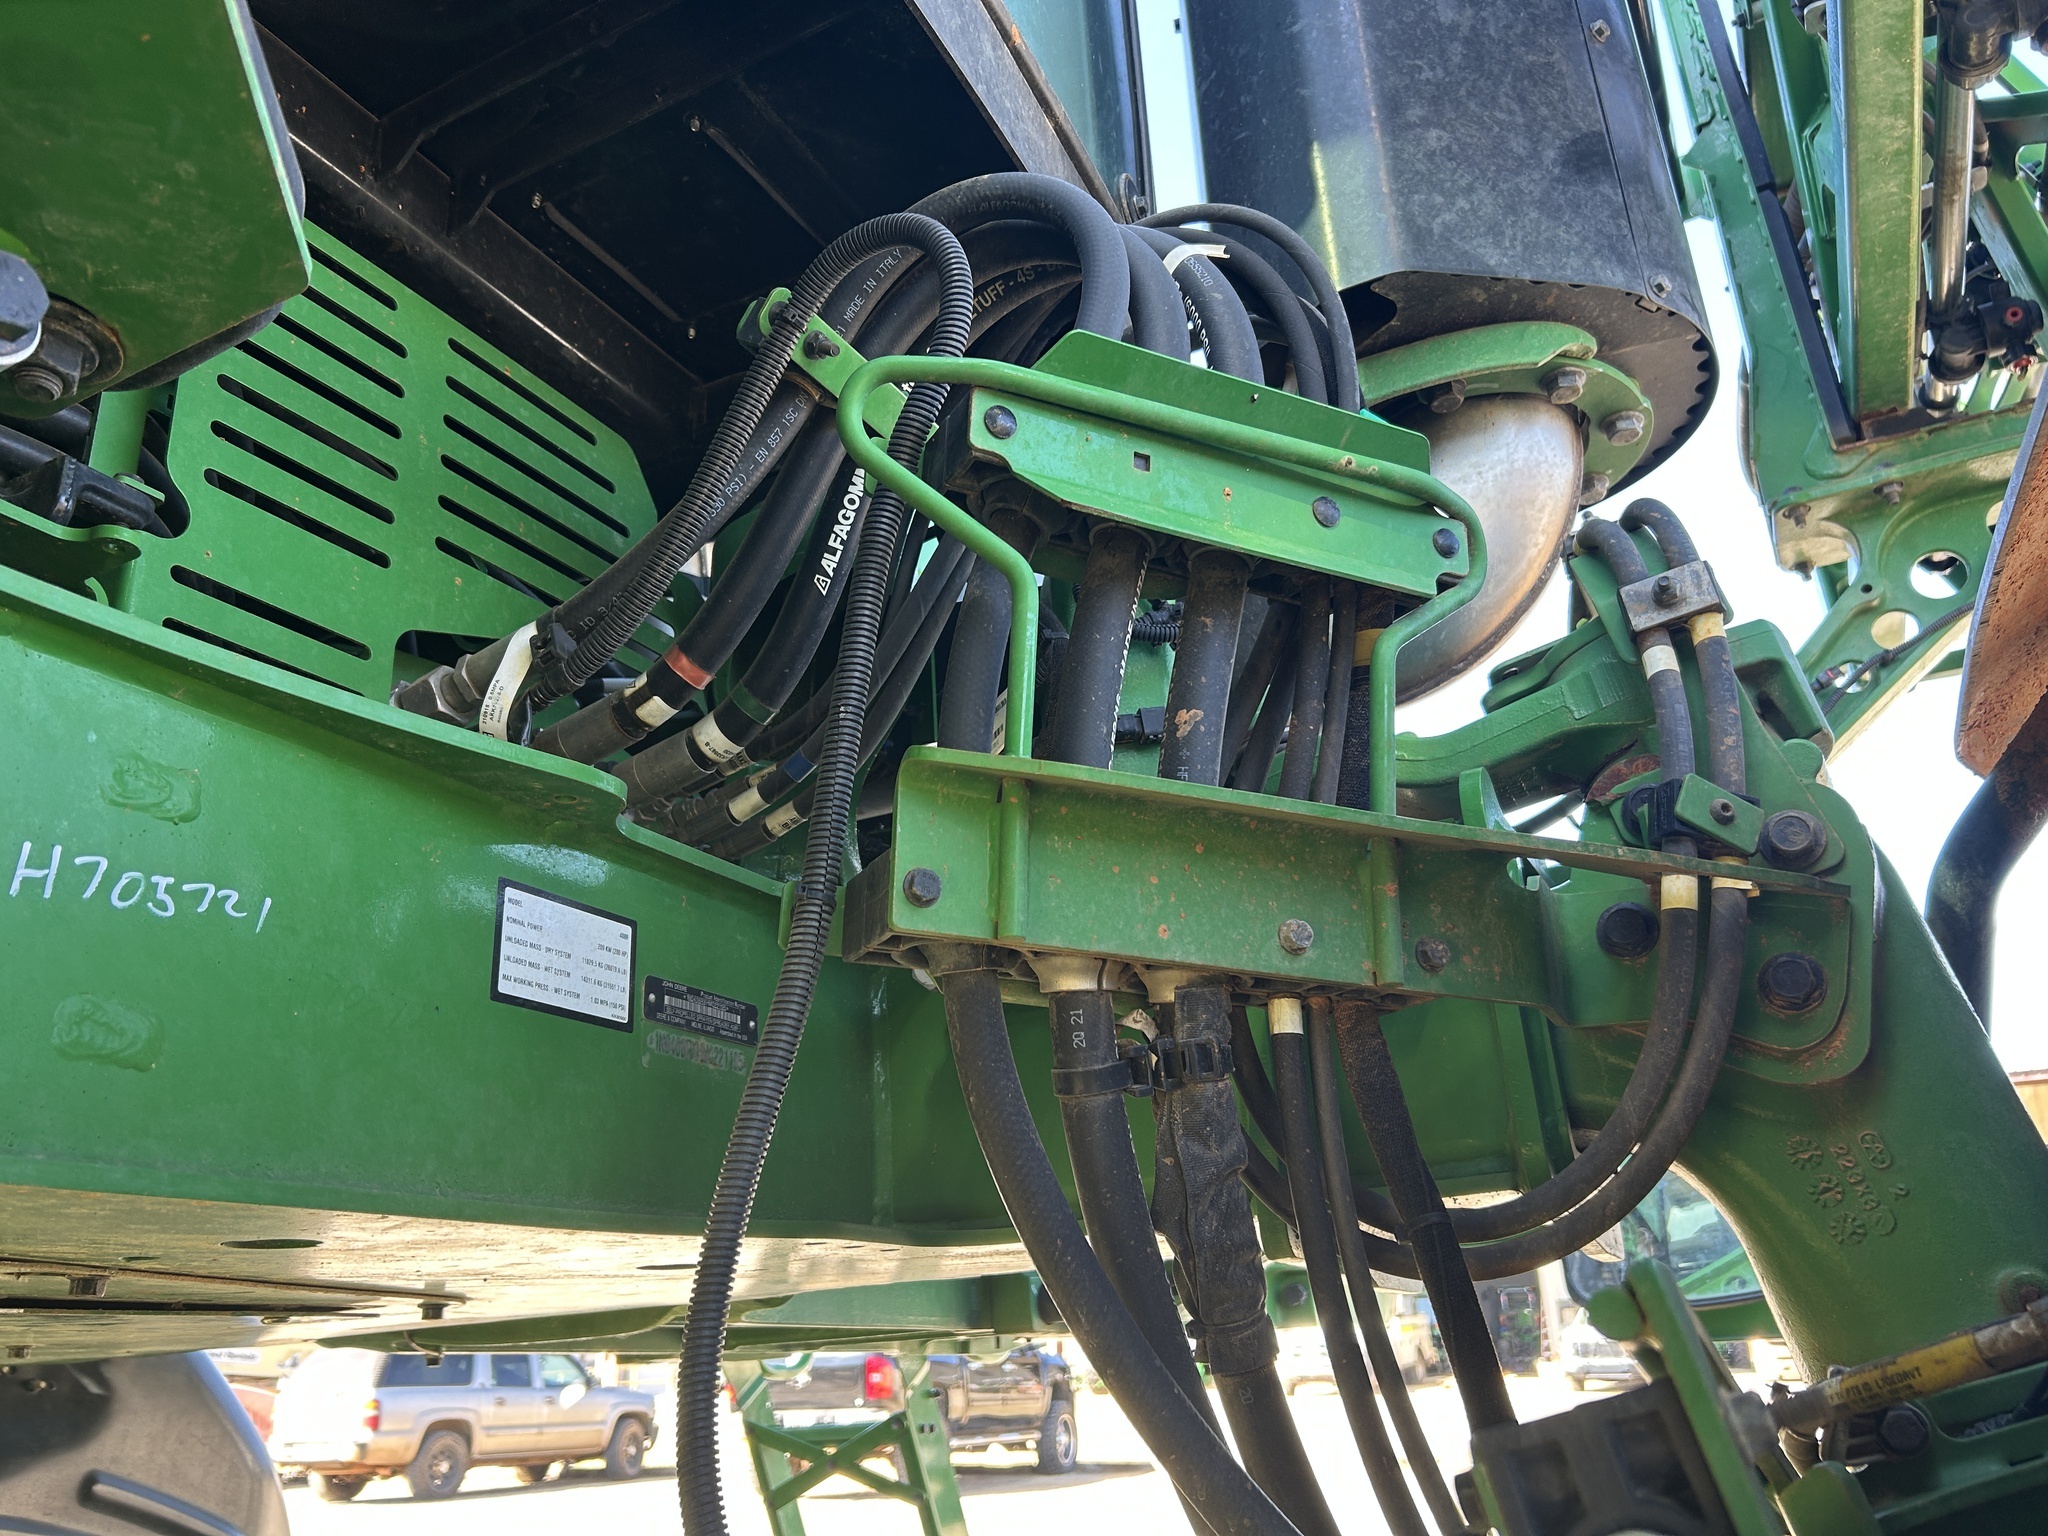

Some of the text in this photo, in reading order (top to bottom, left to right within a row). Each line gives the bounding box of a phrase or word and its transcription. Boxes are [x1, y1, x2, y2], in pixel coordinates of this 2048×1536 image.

[843, 293, 865, 322] MADE
[862, 276, 877, 296] IN
[874, 248, 903, 279] ITALY
[725, 473, 747, 498] PSI)
[755, 446, 769, 463] EN
[767, 427, 784, 448] 857
[782, 407, 799, 428] 1SC
[8, 840, 272, 934] H705721
[507, 896, 522, 907] MODEL
[506, 915, 525, 927] NOMINAL
[527, 921, 542, 932] POWER
[504, 934, 528, 947] UNLOADED
[529, 941, 541, 951] MASS
[544, 946, 553, 954] DRY
[554, 948, 571, 959] SYSTEM
[503, 953, 527, 966] UNLOADED
[528, 960, 540, 970] MASS
[543, 964, 552, 973] WET
[553, 967, 570, 978] SYSTEM
[502, 973, 511, 982] MAX
[512, 976, 534, 988] WORKING
[553, 987, 563, 995] WET
[564, 989, 580, 999] SYSTEM
[599, 999, 608, 1007] MPA
[661, 979, 687, 992] JOHN DEERE
[1070, 1008, 1084, 1026] 21
